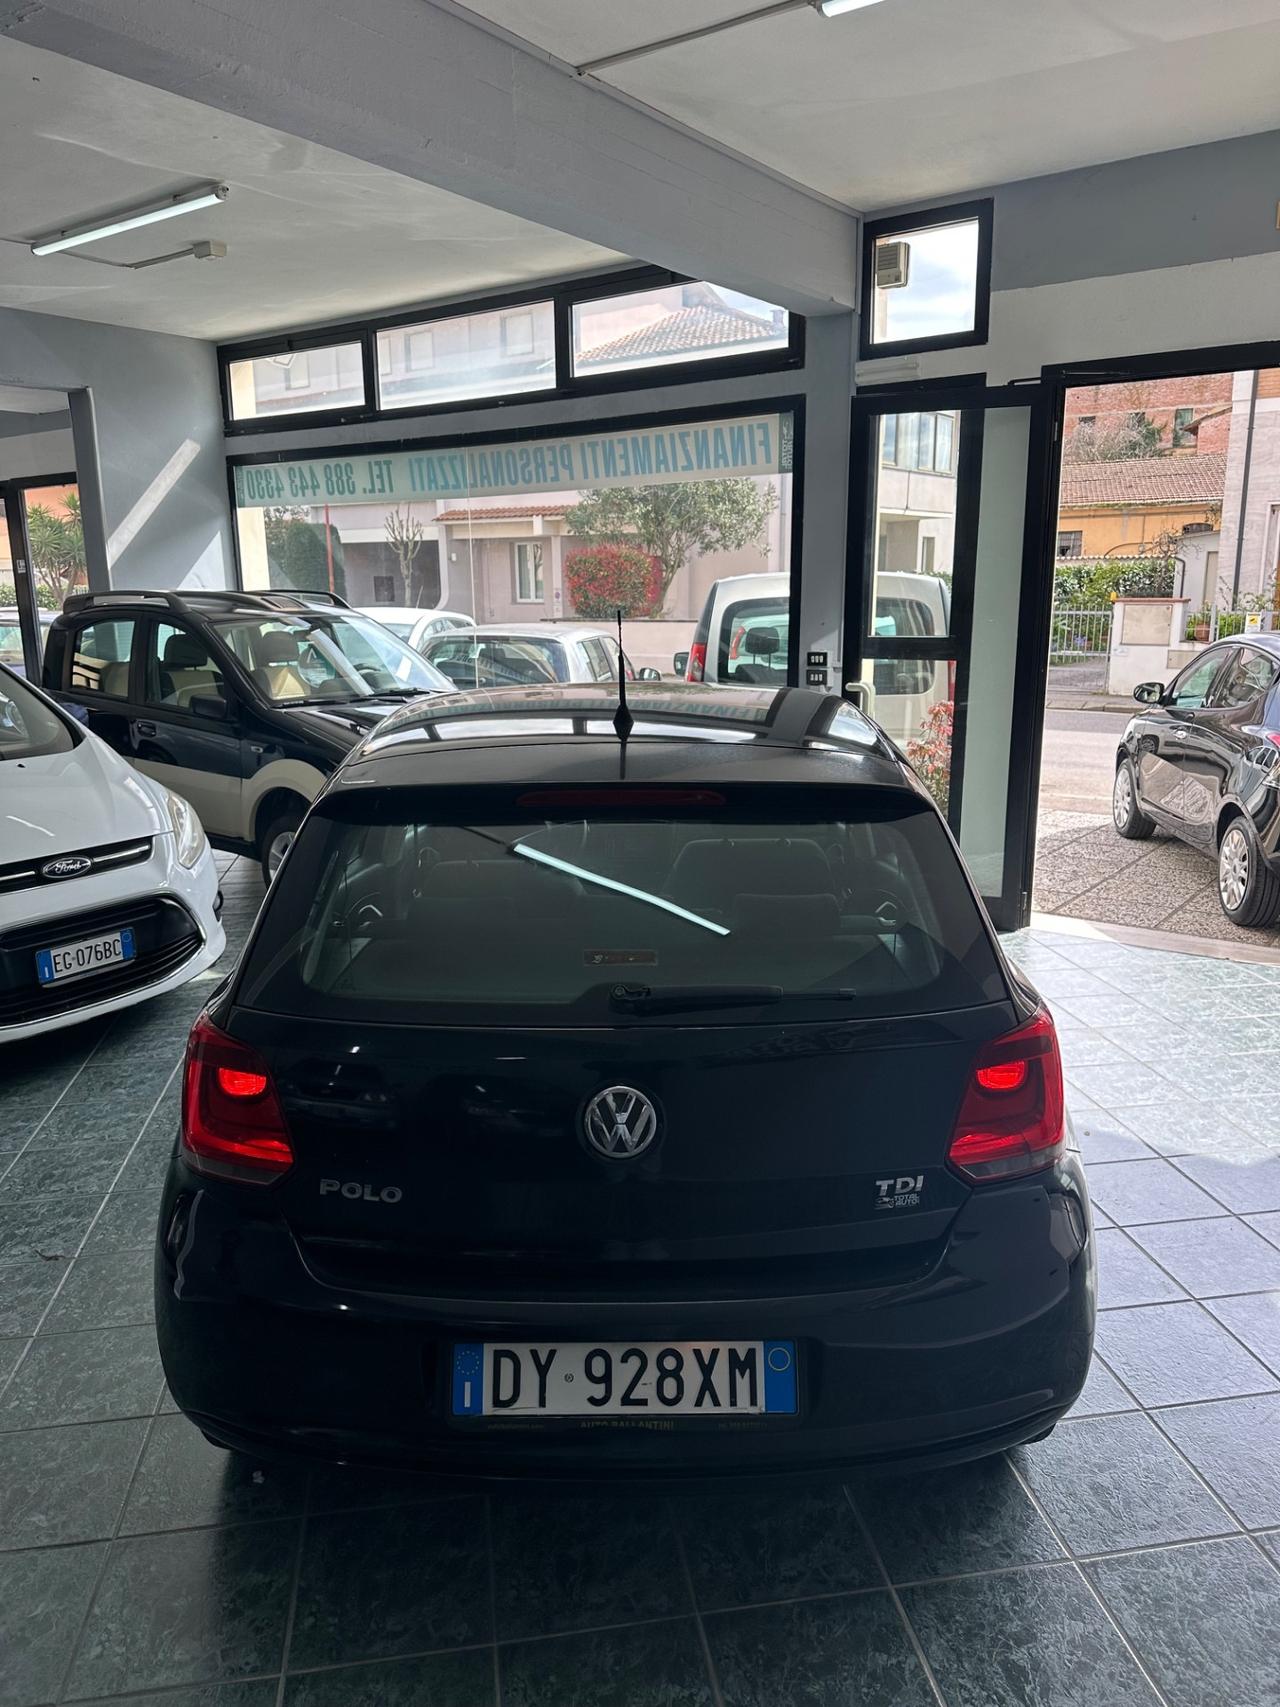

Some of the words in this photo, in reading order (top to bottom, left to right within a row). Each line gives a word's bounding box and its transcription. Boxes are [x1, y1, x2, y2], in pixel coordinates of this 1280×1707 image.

[52, 952, 73, 974] EG
[75, 938, 122, 967] 076BC
[319, 1179, 403, 1203] POLO
[875, 1175, 924, 1197] TDI
[894, 1193, 920, 1201] TOTAL
[491, 1348, 558, 1409] DY
[584, 1347, 759, 1408] 928XM
[463, 1381, 471, 1408] I
